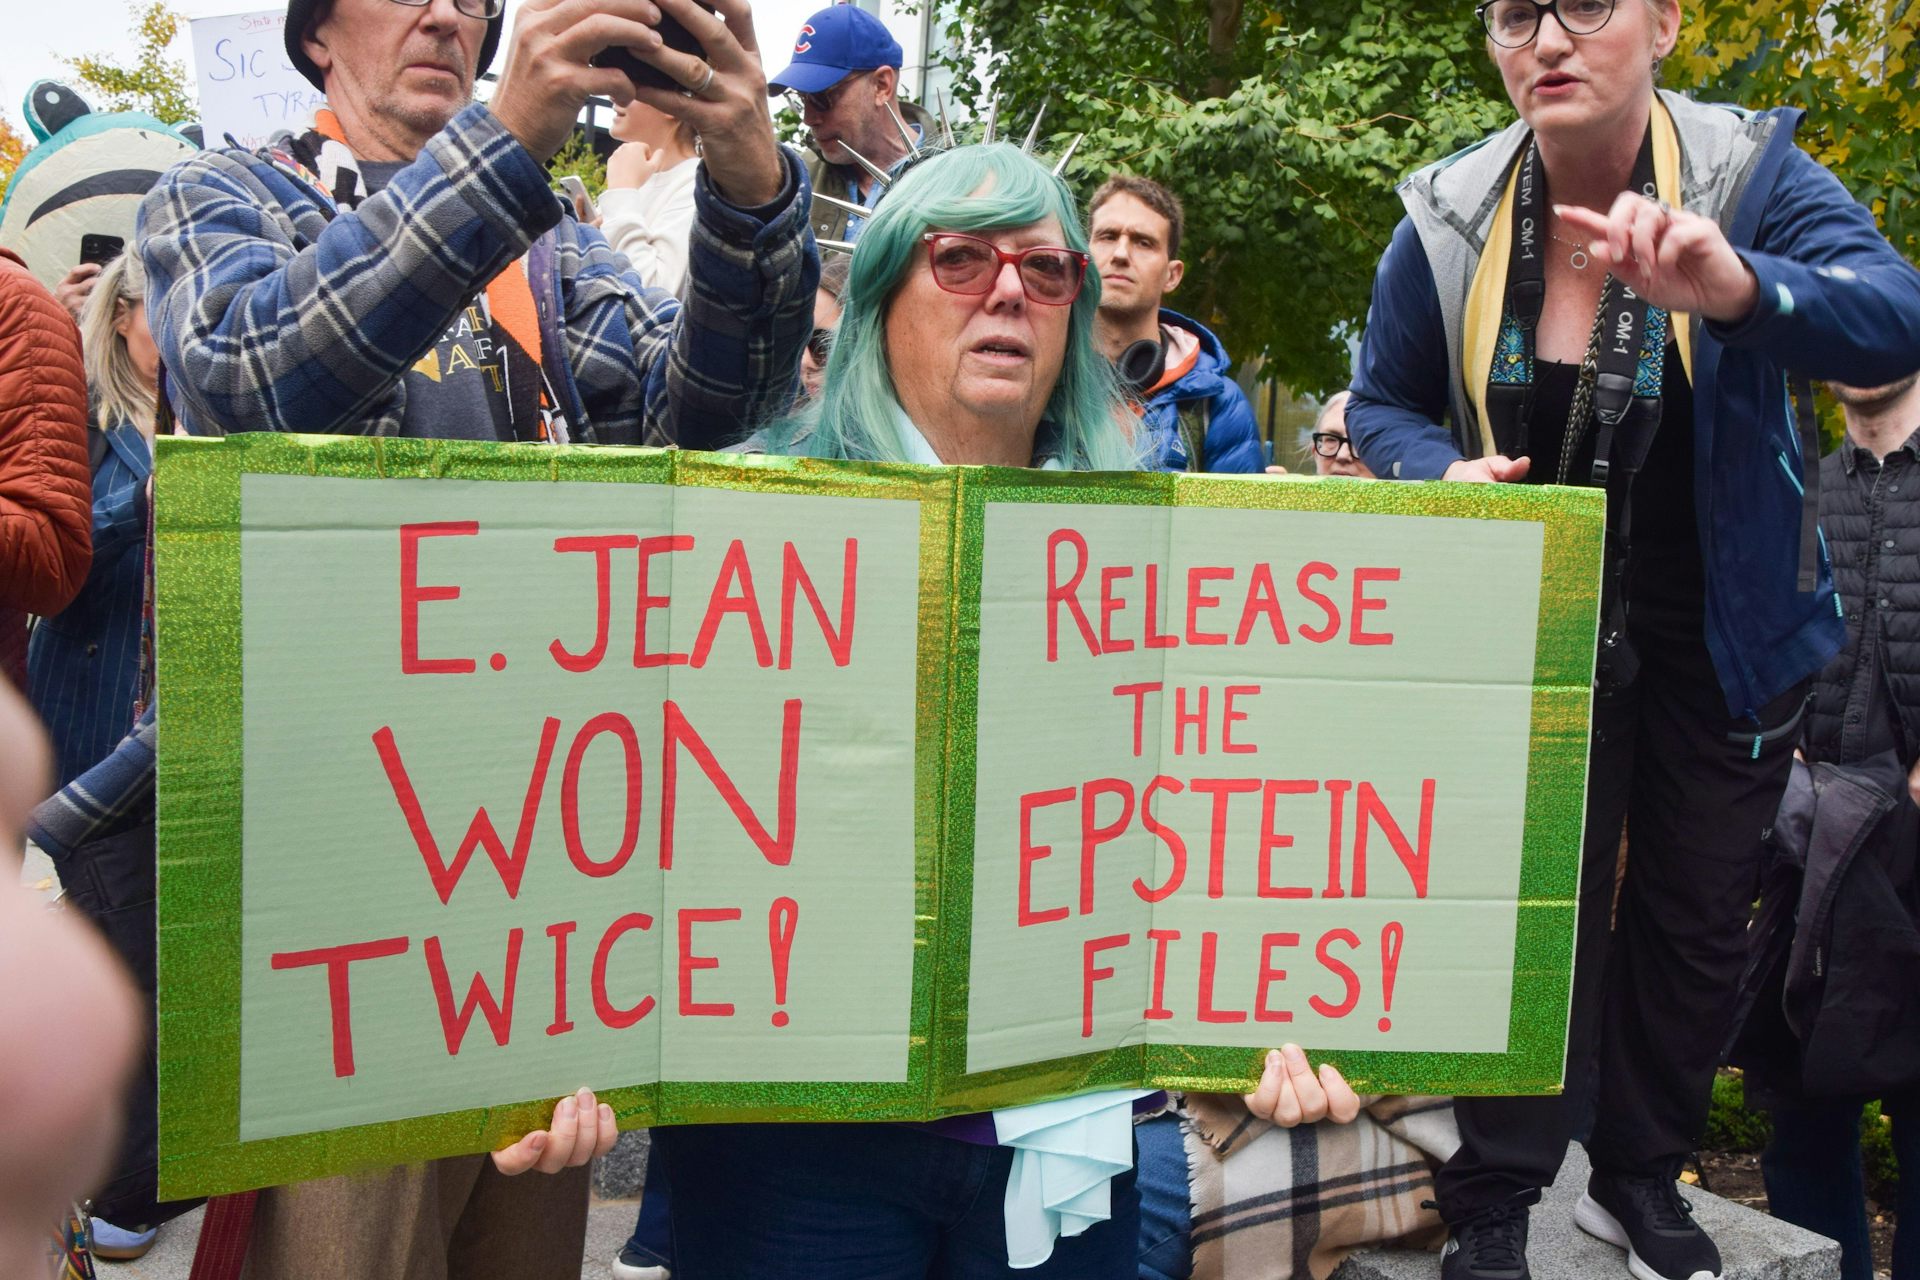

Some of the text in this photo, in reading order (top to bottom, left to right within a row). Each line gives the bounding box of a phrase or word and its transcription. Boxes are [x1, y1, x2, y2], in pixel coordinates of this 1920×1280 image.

[795, 24, 816, 54] C
[1521, 217, 1534, 260] OM-1
[1613, 311, 1634, 355] OM-1
[400, 521, 858, 674] E. JEAN
[1047, 529, 1400, 662] RELEASE
[1114, 682, 1262, 757] THE
[372, 699, 801, 903] WON
[1019, 775, 1435, 928] EPSTEIN
[272, 897, 798, 1077] TWICE!
[1081, 922, 1404, 1037] FILES!
